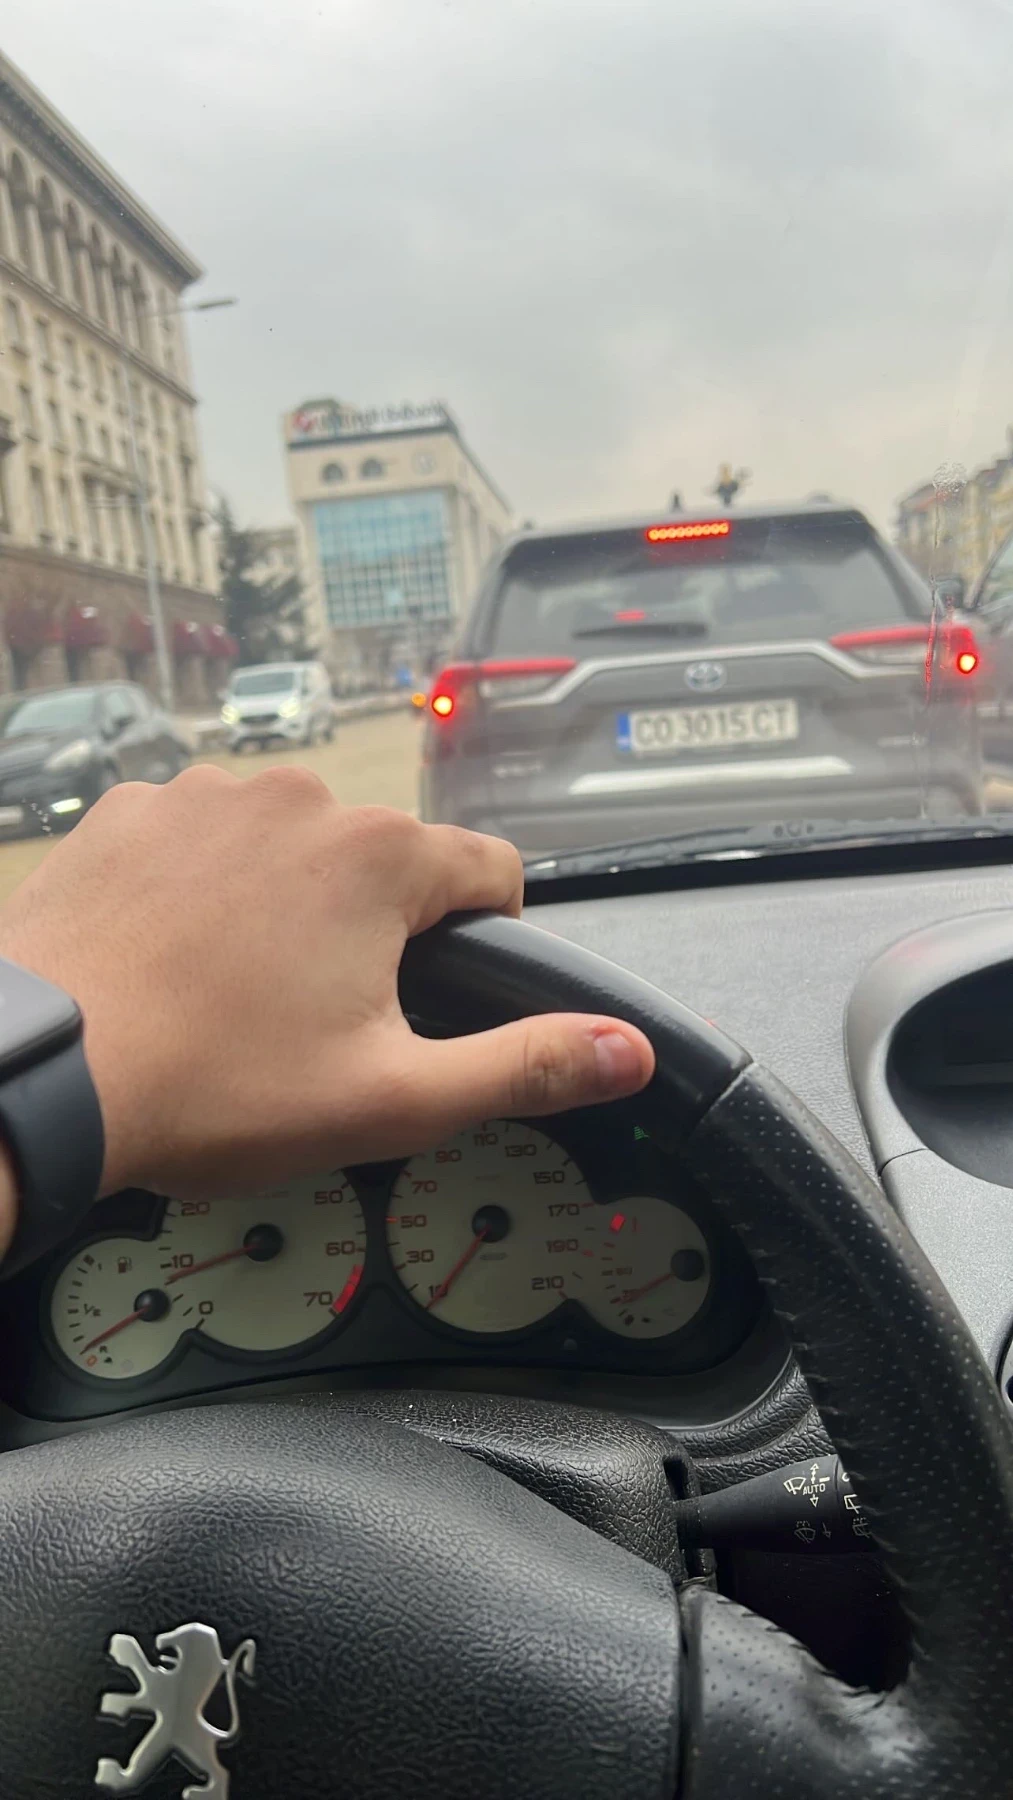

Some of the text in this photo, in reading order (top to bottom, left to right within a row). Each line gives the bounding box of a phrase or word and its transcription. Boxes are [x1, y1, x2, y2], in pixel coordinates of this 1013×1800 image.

[435, 1150, 462, 1164] 90
[505, 1144, 537, 1158] 130
[533, 1171, 566, 1185] 150
[411, 1181, 438, 1194] 70
[314, 1190, 344, 1205] 50
[180, 1202, 211, 1216] 20
[547, 1203, 580, 1218] 170
[400, 1215, 427, 1229] 50
[325, 1241, 357, 1256] 60
[546, 1239, 579, 1253] 190
[171, 1254, 194, 1269] 10
[405, 1250, 434, 1264] 30
[531, 1276, 565, 1291] 210
[304, 1291, 334, 1308] 70
[199, 1301, 214, 1316] 0
[803, 1483, 826, 1495] AUTO
